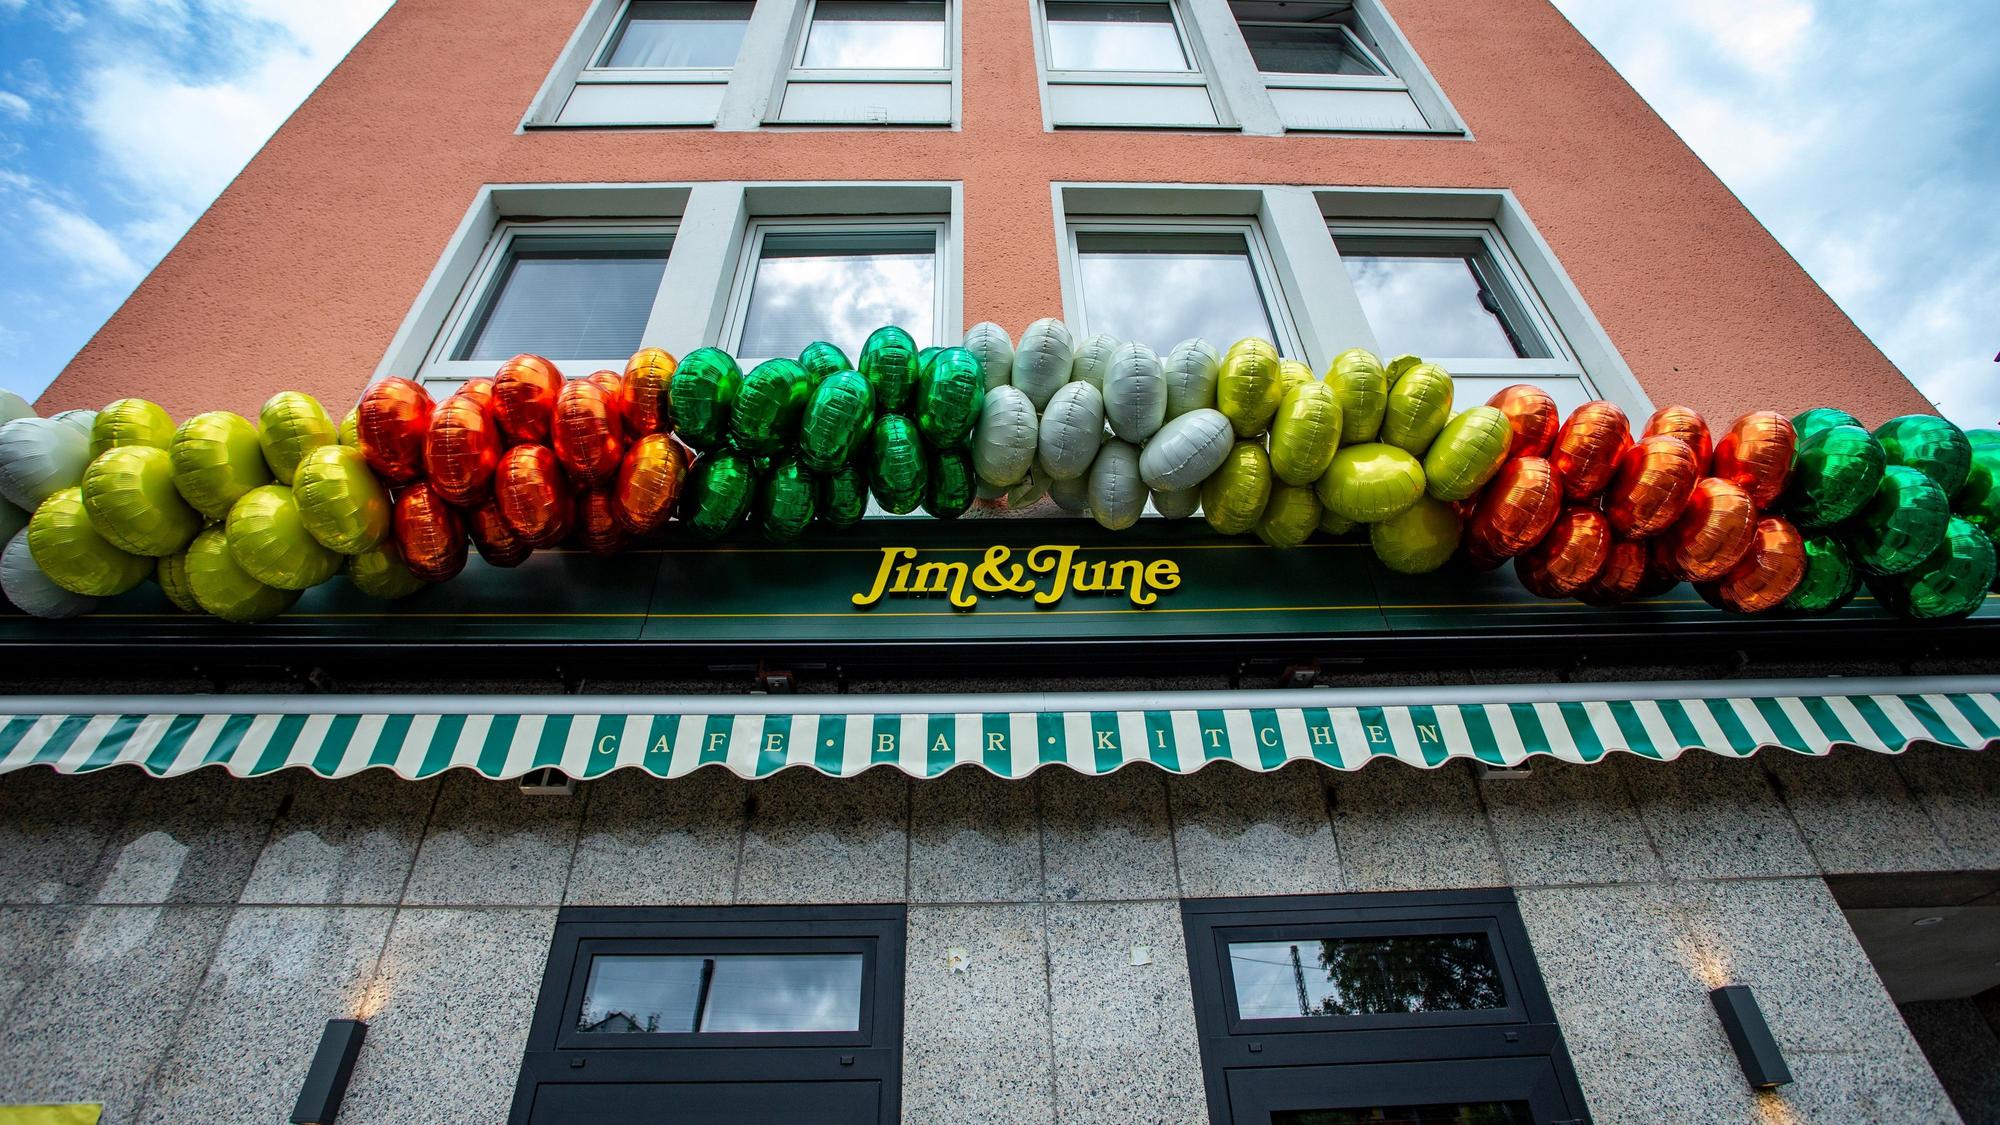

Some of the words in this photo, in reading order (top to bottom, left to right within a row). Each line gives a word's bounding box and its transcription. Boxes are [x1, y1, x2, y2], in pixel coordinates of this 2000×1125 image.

[852, 545, 1181, 607] Jim&June
[597, 733, 784, 756] CAFE
[876, 732, 1007, 753] BAR
[1096, 724, 1440, 750] KITCHEN
